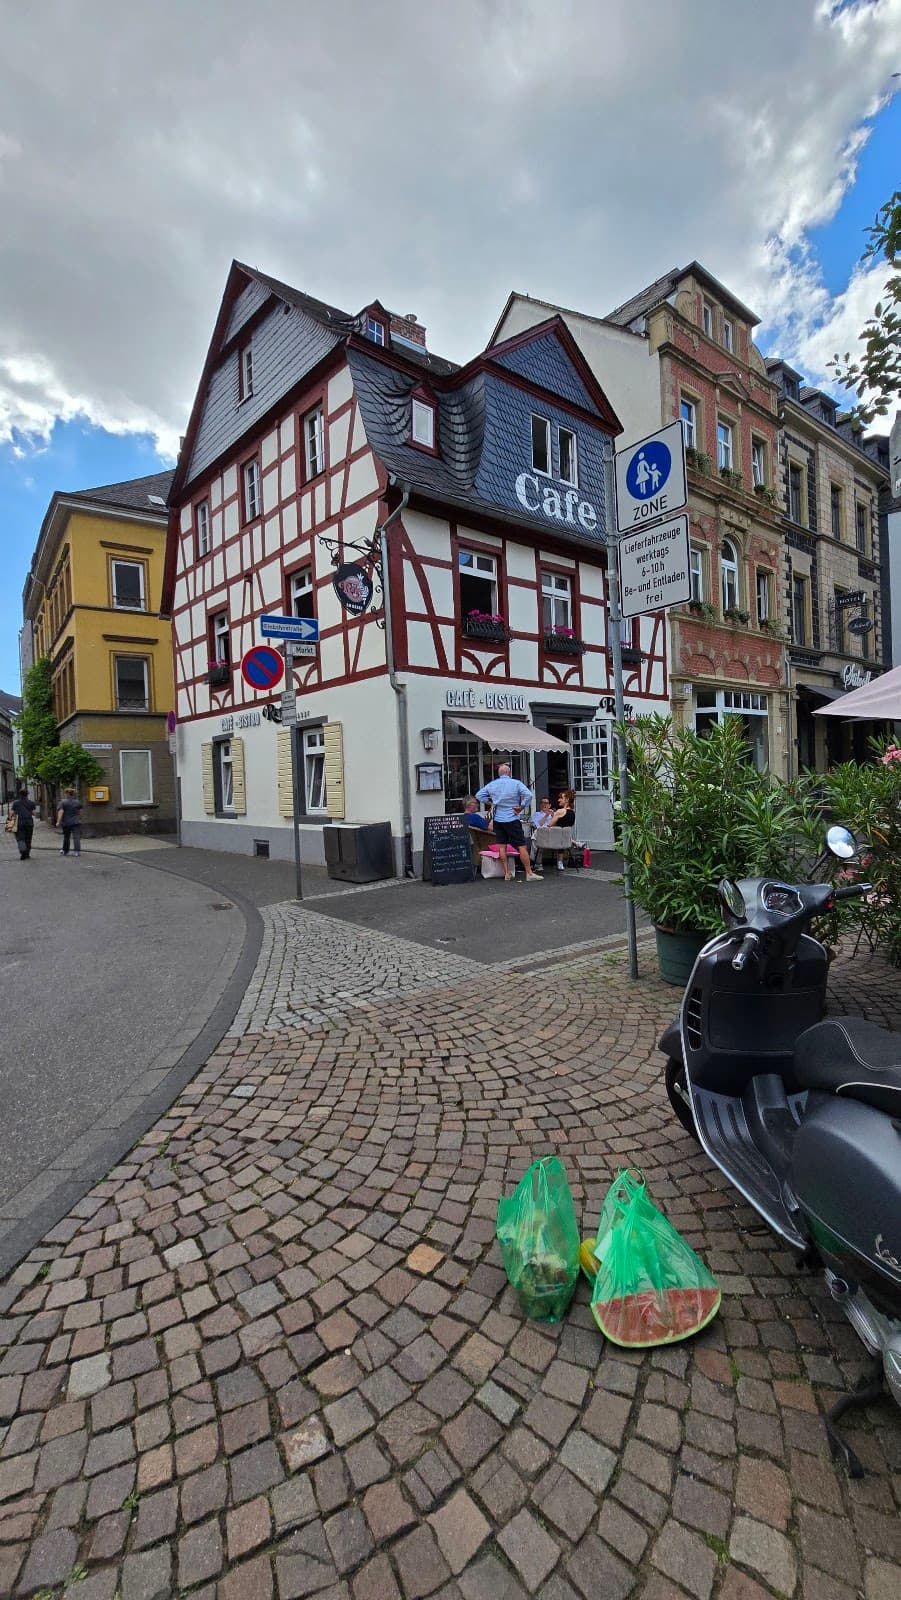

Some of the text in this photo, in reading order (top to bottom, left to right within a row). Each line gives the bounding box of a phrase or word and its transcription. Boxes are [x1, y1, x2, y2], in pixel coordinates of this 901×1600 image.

[515, 473, 597, 530] Cafe
[633, 494, 668, 521] ZONE
[624, 527, 681, 555] Lieferfahrzeuge
[636, 546, 670, 564] werktags
[652, 571, 686, 588] Entladen
[646, 590, 663, 605] frei
[839, 595, 860, 605] HOTEL
[295, 645, 313, 654] Markt
[446, 688, 476, 708] CAFÉ
[485, 692, 526, 711] BISTRO
